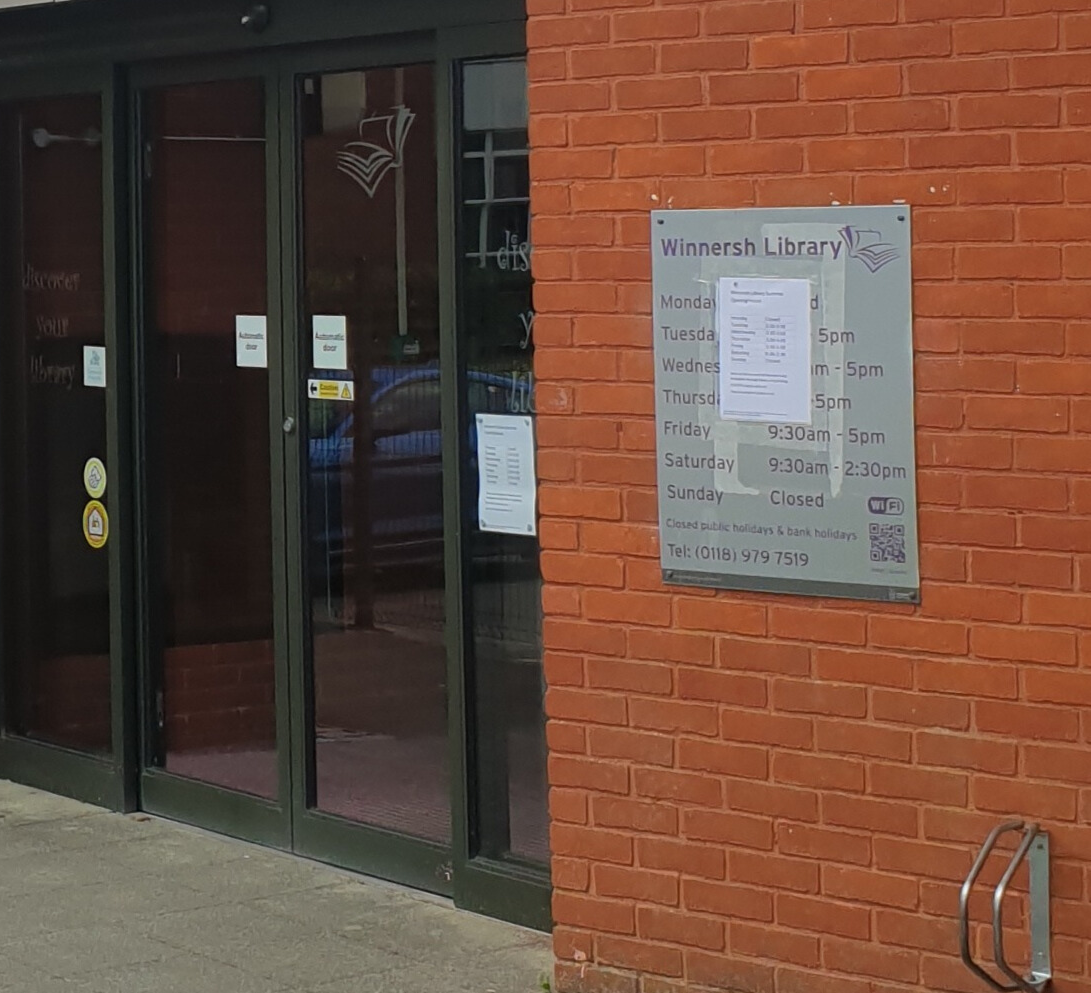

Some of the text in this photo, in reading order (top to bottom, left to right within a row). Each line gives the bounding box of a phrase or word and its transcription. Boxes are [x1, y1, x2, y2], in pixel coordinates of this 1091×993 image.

[661, 237, 843, 259] Winnersh Library
[661, 326, 855, 345] Tuesda 5pm
[662, 357, 720, 373] Wednes
[847, 362, 884, 379] 5pm
[662, 389, 720, 405] Thursd
[664, 421, 711, 440] Friday
[768, 425, 830, 442] 9:30am
[848, 428, 885, 446] 5pm
[665, 452, 734, 473] Saturday
[769, 457, 829, 475] 9:30am
[845, 461, 906, 480] 2:30pm
[667, 484, 824, 508] Sunday Closed
[666, 518, 698, 530] Closed
[733, 523, 774, 536] holidays
[787, 526, 811, 537] bank
[814, 528, 858, 542] holidays
[667, 543, 808, 566] Tel: (0118) 979 7519
